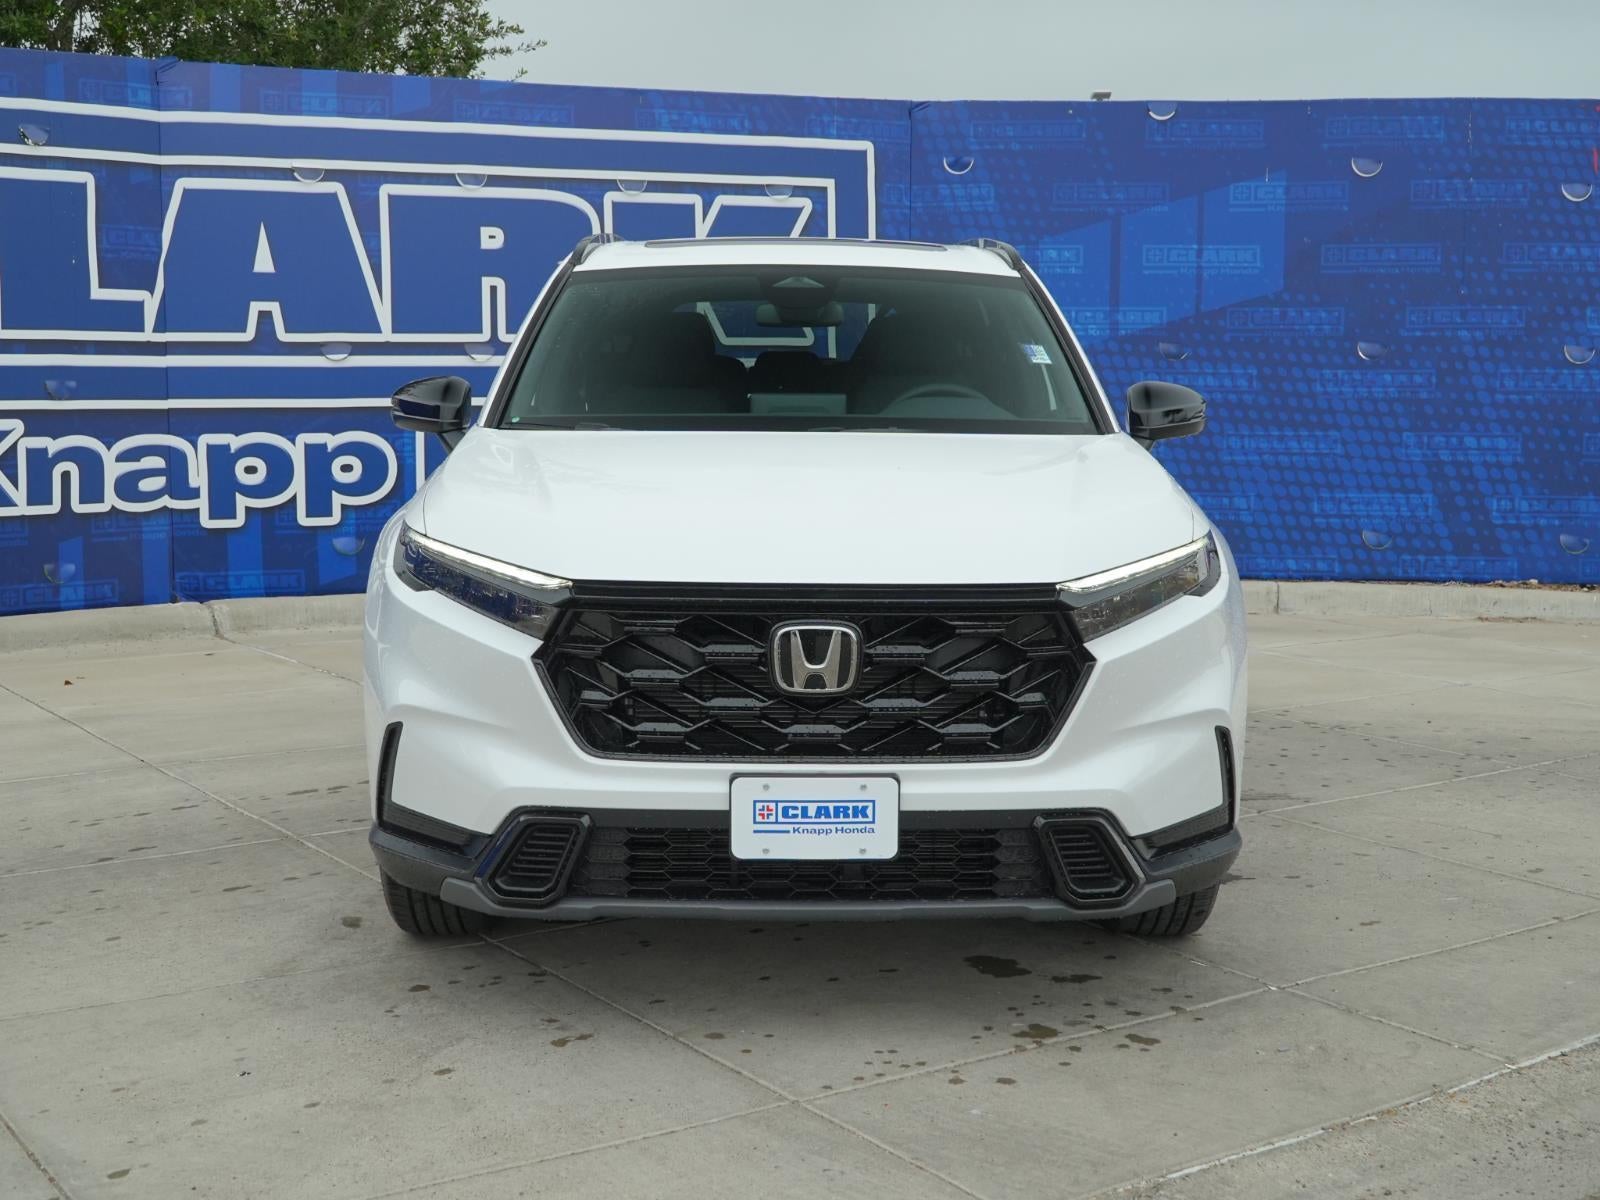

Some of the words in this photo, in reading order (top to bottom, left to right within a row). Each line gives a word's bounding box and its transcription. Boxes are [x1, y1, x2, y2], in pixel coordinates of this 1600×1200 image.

[781, 805, 870, 819] CLARK
[792, 826, 833, 836] Knapp
[835, 826, 875, 834] Honda
